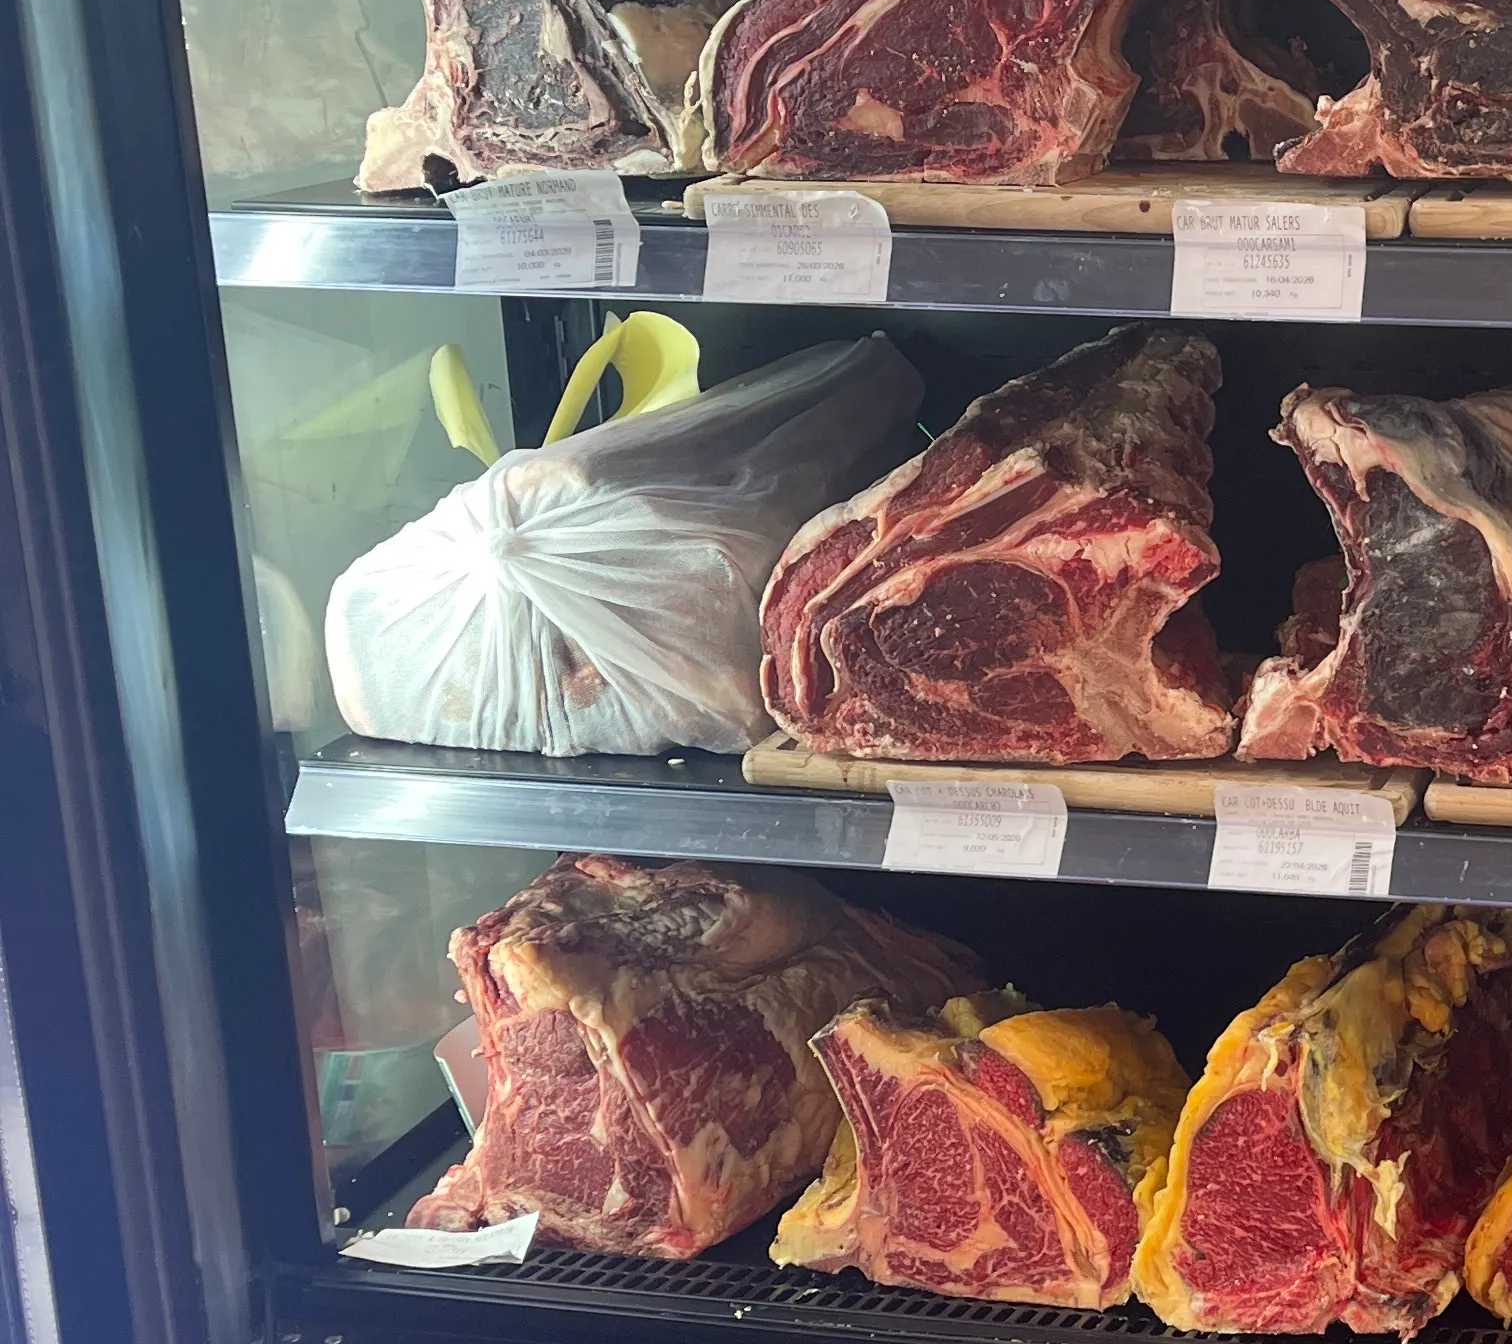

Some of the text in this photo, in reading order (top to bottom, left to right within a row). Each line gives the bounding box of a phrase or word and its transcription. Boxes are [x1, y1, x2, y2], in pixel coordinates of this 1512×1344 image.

[497, 181, 533, 198] MATURE
[536, 178, 577, 195] NORMAND
[744, 203, 797, 219] SIMMENTAL
[801, 204, 820, 219] DES
[1176, 214, 1301, 231] CAR BRUT MATUR SALERS
[1243, 253, 1291, 269] 61245635
[948, 786, 982, 798] DESSUS
[1222, 796, 1239, 807] CAR
[1333, 801, 1361, 816] AQUIT
[1258, 841, 1304, 855] 61195157
